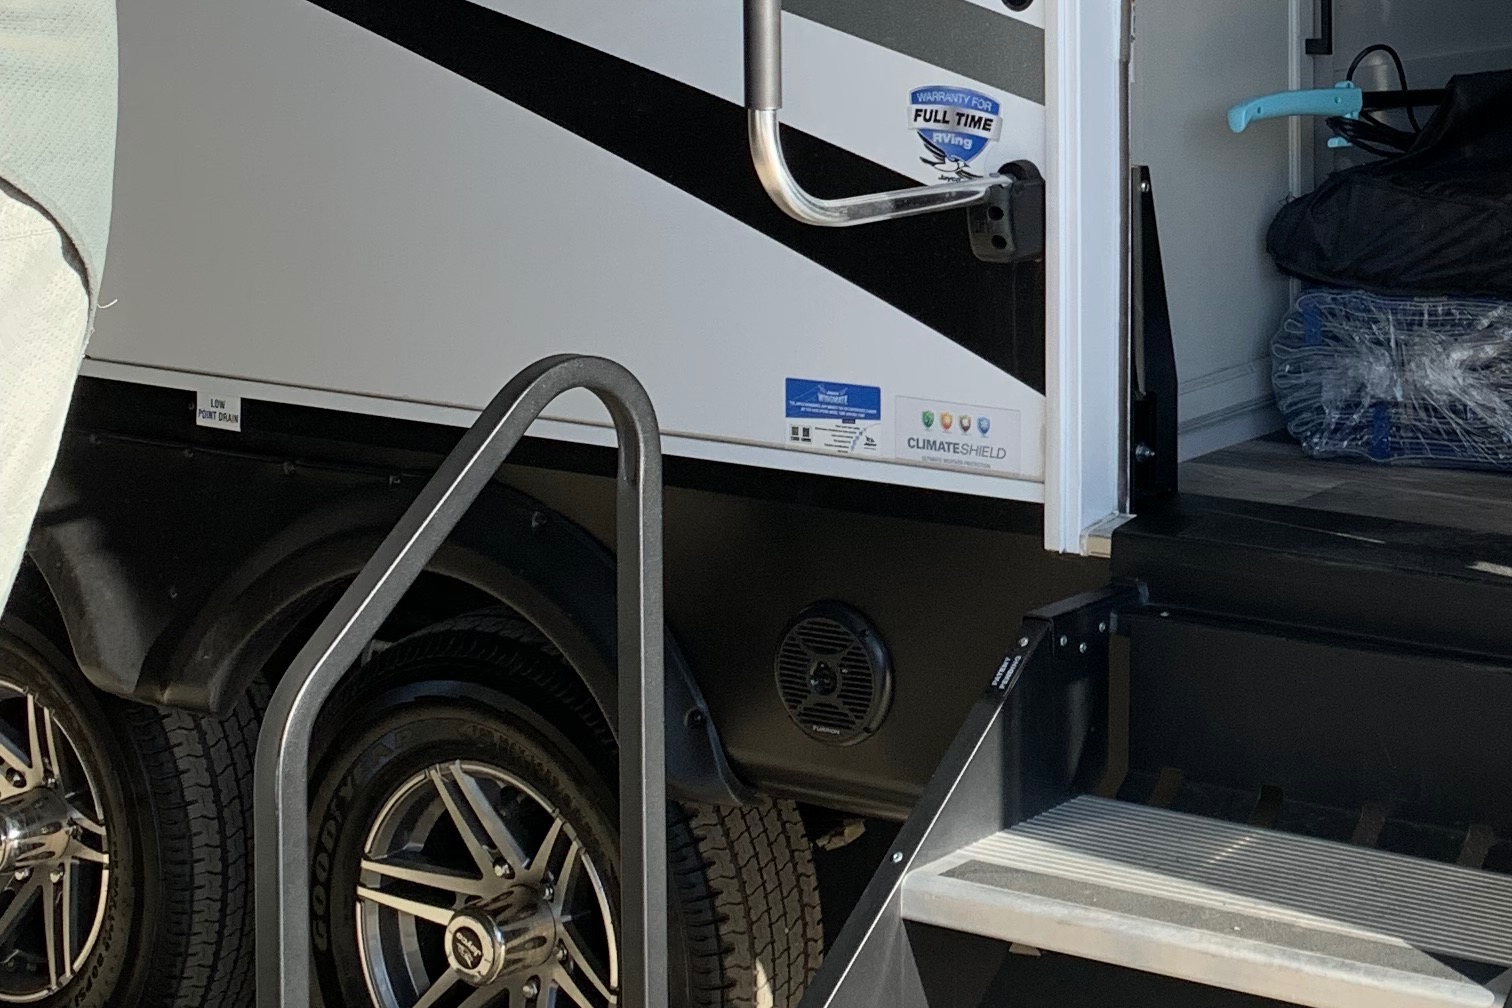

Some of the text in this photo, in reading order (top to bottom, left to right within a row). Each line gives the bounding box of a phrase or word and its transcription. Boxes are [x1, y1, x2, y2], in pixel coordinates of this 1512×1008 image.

[917, 91, 992, 112] WARRANTY FOR
[913, 108, 994, 132] FULL TIME
[932, 132, 973, 150] RVing
[210, 399, 225, 408] LOW
[198, 408, 238, 422] POINT DRAIN
[907, 436, 1007, 460] CLIMATESHIELD
[991, 656, 1010, 686] PATENT
[998, 655, 1021, 689] PENDING
